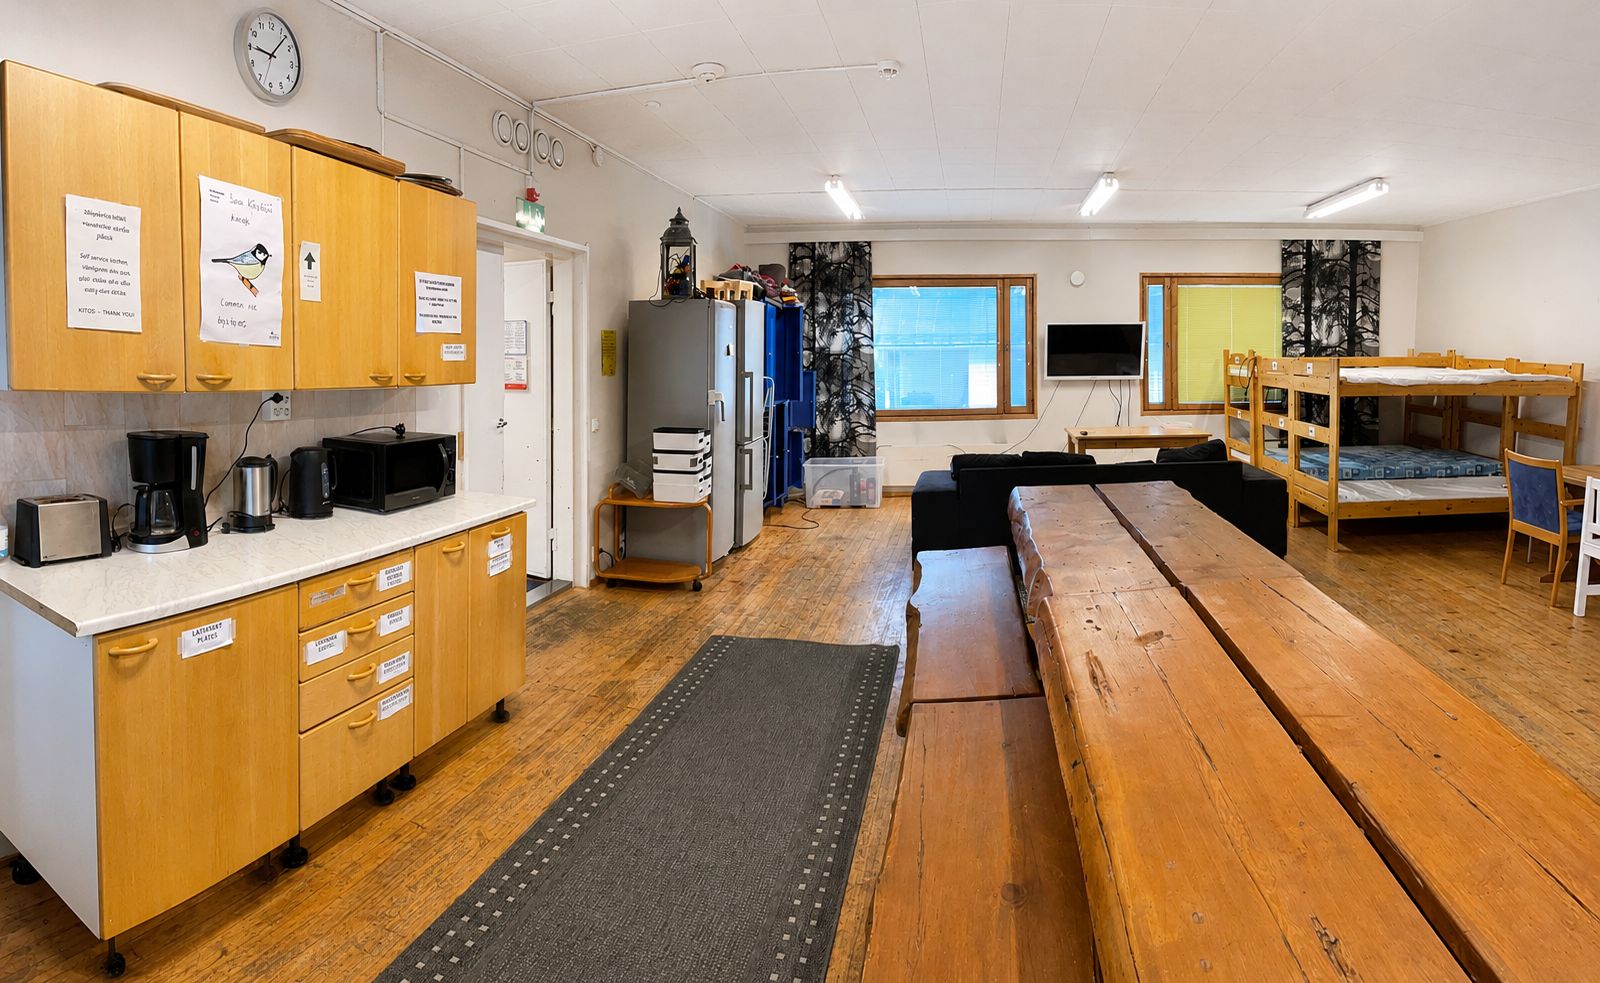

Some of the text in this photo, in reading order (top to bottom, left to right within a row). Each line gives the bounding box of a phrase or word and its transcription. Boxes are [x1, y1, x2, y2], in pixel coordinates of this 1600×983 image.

[258, 22, 265, 30] 11
[268, 21, 275, 31] 12
[290, 61, 294, 70] 3
[258, 73, 262, 82] 7
[286, 74, 291, 82] 4
[279, 82, 284, 90] 5
[102, 309, 121, 317] THANK
